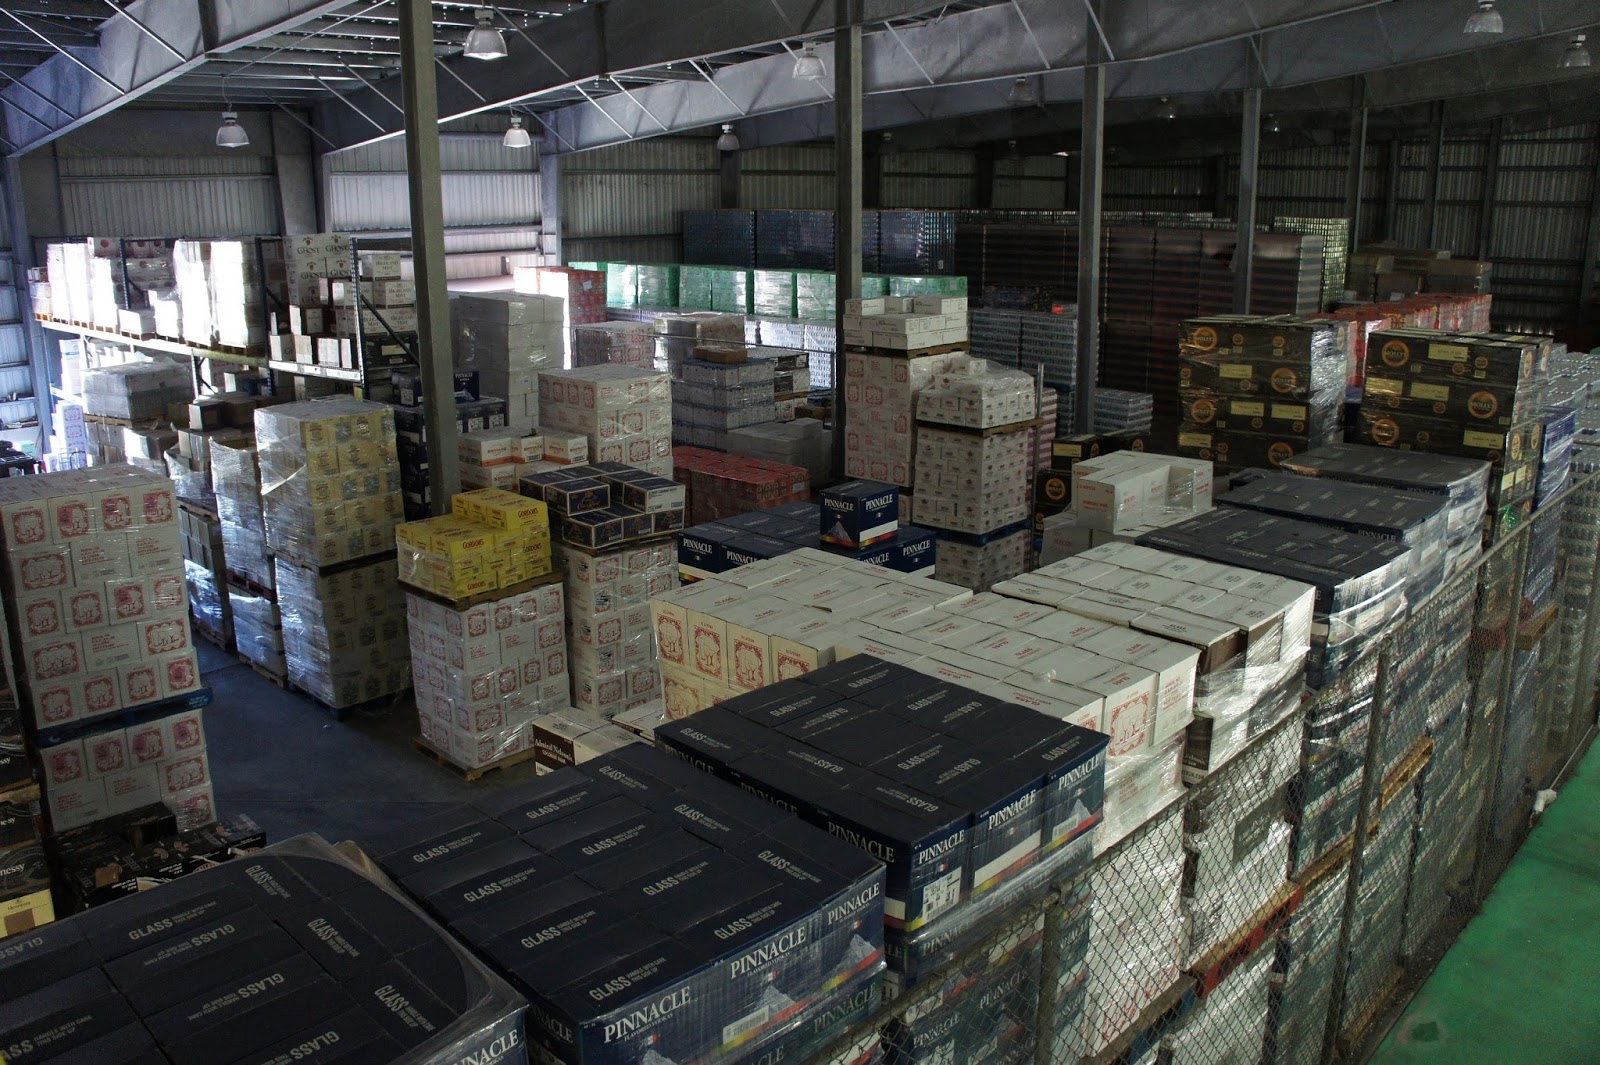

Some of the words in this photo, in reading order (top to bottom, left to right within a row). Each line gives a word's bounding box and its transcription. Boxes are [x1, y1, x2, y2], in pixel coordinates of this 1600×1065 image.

[297, 247, 320, 255] GHOST
[326, 245, 348, 253] GHOST
[824, 498, 854, 511] PINNACLE
[865, 493, 893, 511] PINNACLE
[683, 537, 713, 554] PINNACLE
[903, 539, 931, 556] PINNACLE
[726, 551, 758, 564] PINNACL
[680, 727, 706, 741] GLASS
[665, 746, 714, 775] PIACLE
[813, 757, 844, 774] GLASS
[897, 755, 926, 770] GLASS
[599, 765, 626, 781] GLASS
[1057, 754, 1101, 792] PINNACLE
[740, 782, 798, 815] PIACLE
[906, 796, 939, 812] GLASS
[526, 803, 560, 819] GLASS
[674, 803, 704, 821] GLASS
[987, 788, 1037, 832] PINNACLE
[581, 838, 618, 856] GLASS
[827, 820, 895, 863] PINNACLE
[918, 828, 966, 865] PINNACLE
[412, 844, 449, 863] GLASS
[757, 850, 791, 870] GLASS
[0, 863, 25, 877] nessy
[245, 864, 273, 884] GLASS
[463, 882, 503, 903] GLASS
[642, 876, 680, 897] GLASS
[827, 881, 880, 926] PINNACLE
[128, 918, 174, 941] GLASS
[191, 924, 236, 947] GLASS
[306, 917, 339, 941] GLASS
[520, 926, 561, 949] GLASS
[714, 917, 752, 940] GLASS
[730, 926, 808, 980] PINNACLE
[238, 973, 285, 999] GLASS
[588, 975, 632, 1001] GLASS
[374, 984, 410, 1012] GLASS
[813, 982, 877, 1034] PINNACLE
[603, 985, 693, 1044] PINNACLE
[289, 1030, 340, 1061] GLASS
[455, 1029, 519, 1065] NACLE
